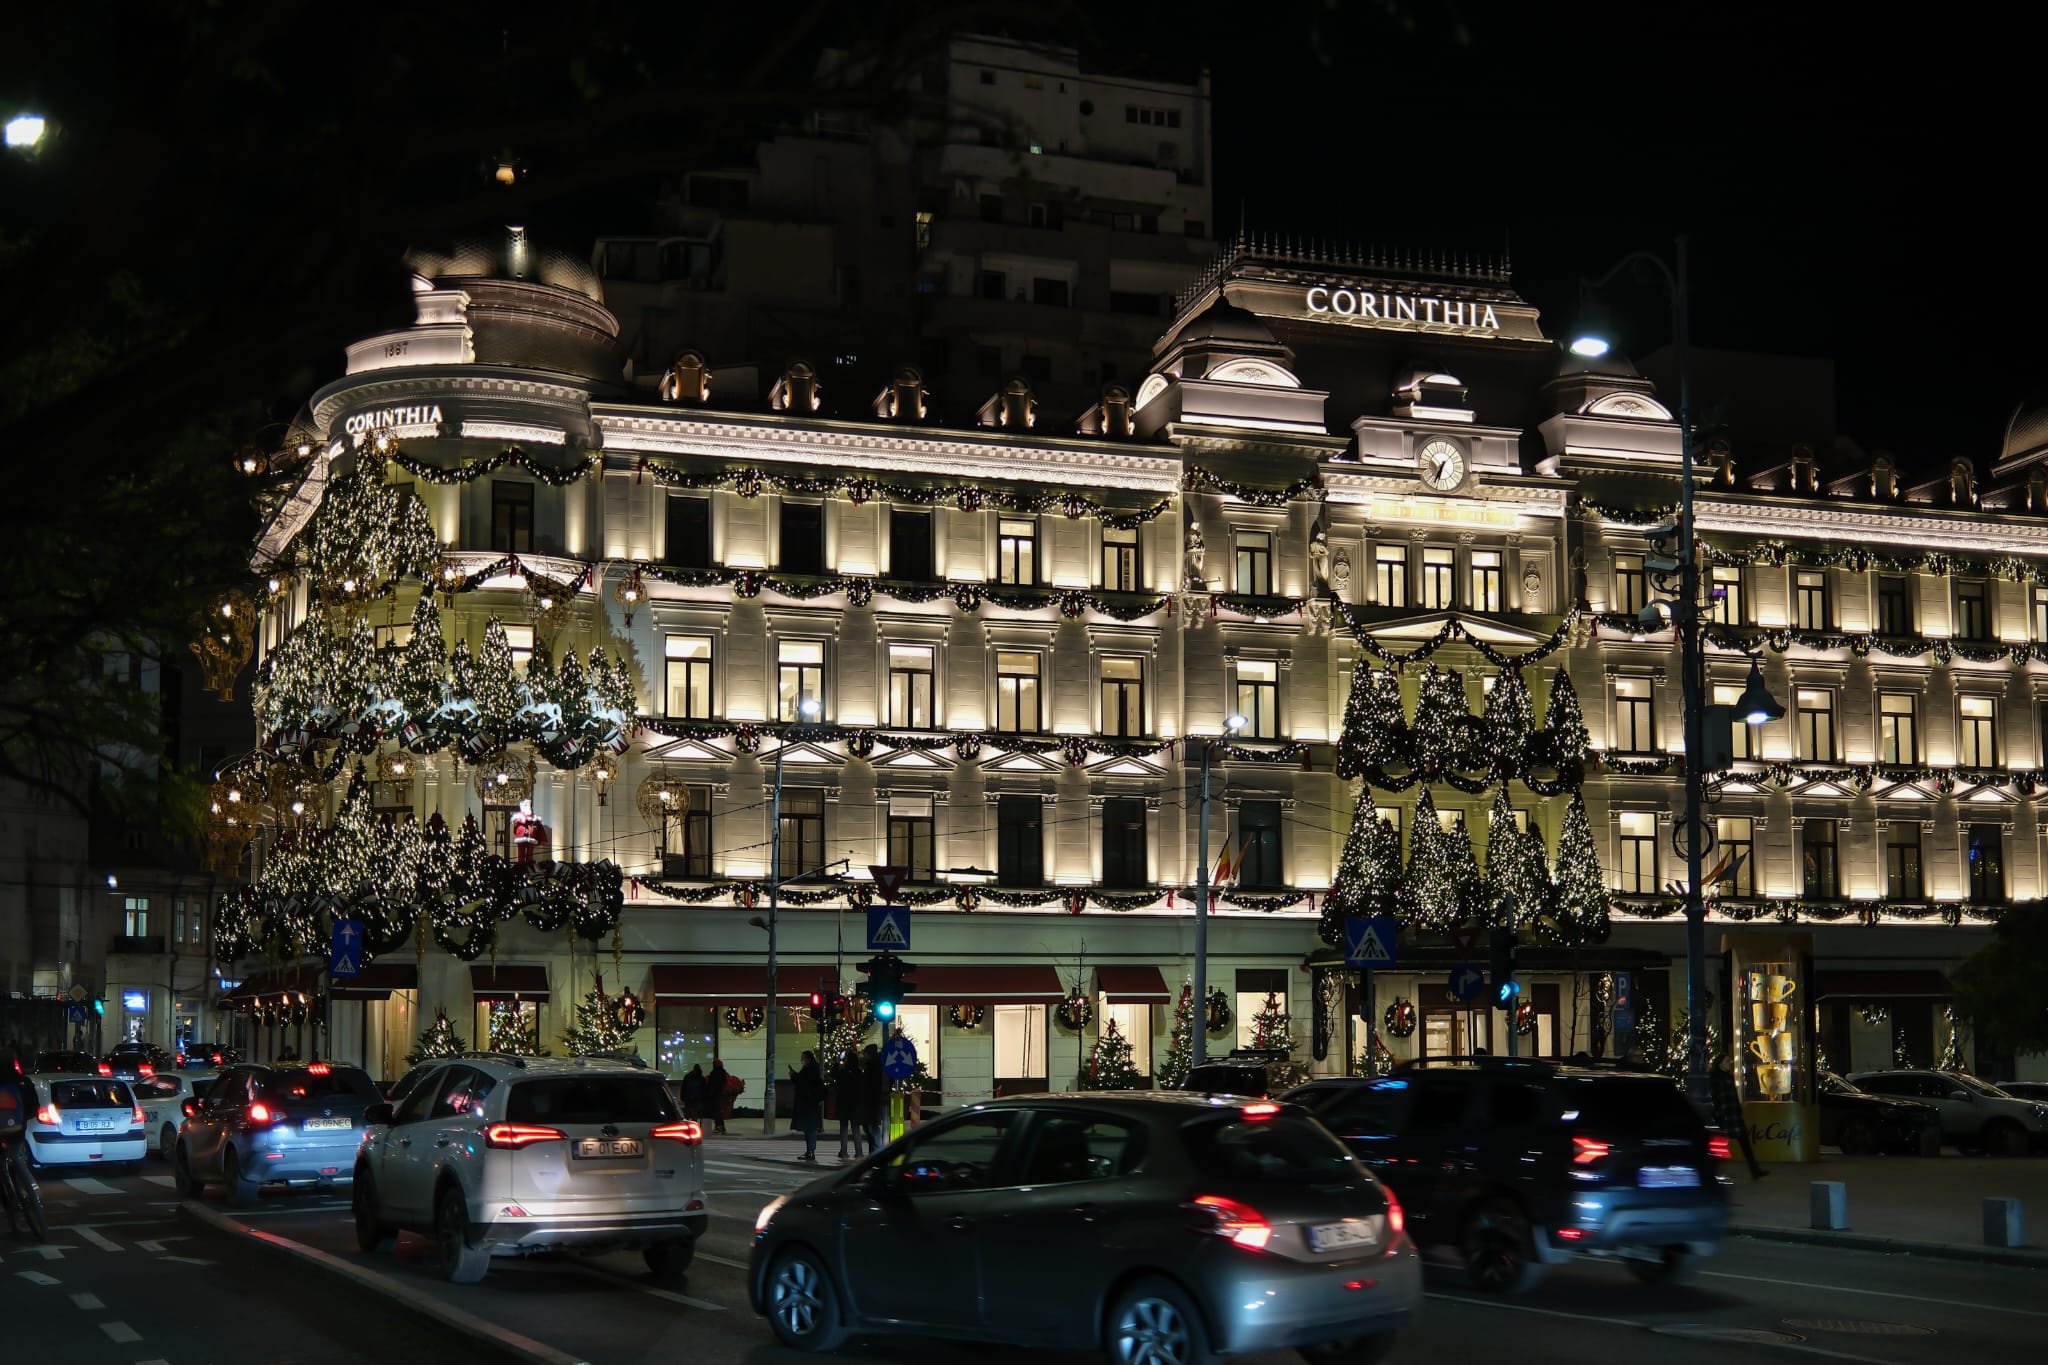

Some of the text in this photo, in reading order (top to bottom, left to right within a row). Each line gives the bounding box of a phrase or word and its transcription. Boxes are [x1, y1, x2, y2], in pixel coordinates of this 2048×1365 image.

[1306, 287, 1499, 329] CORINTHIA
[345, 405, 443, 434] CORINTHIA
[582, 1144, 593, 1155] IF
